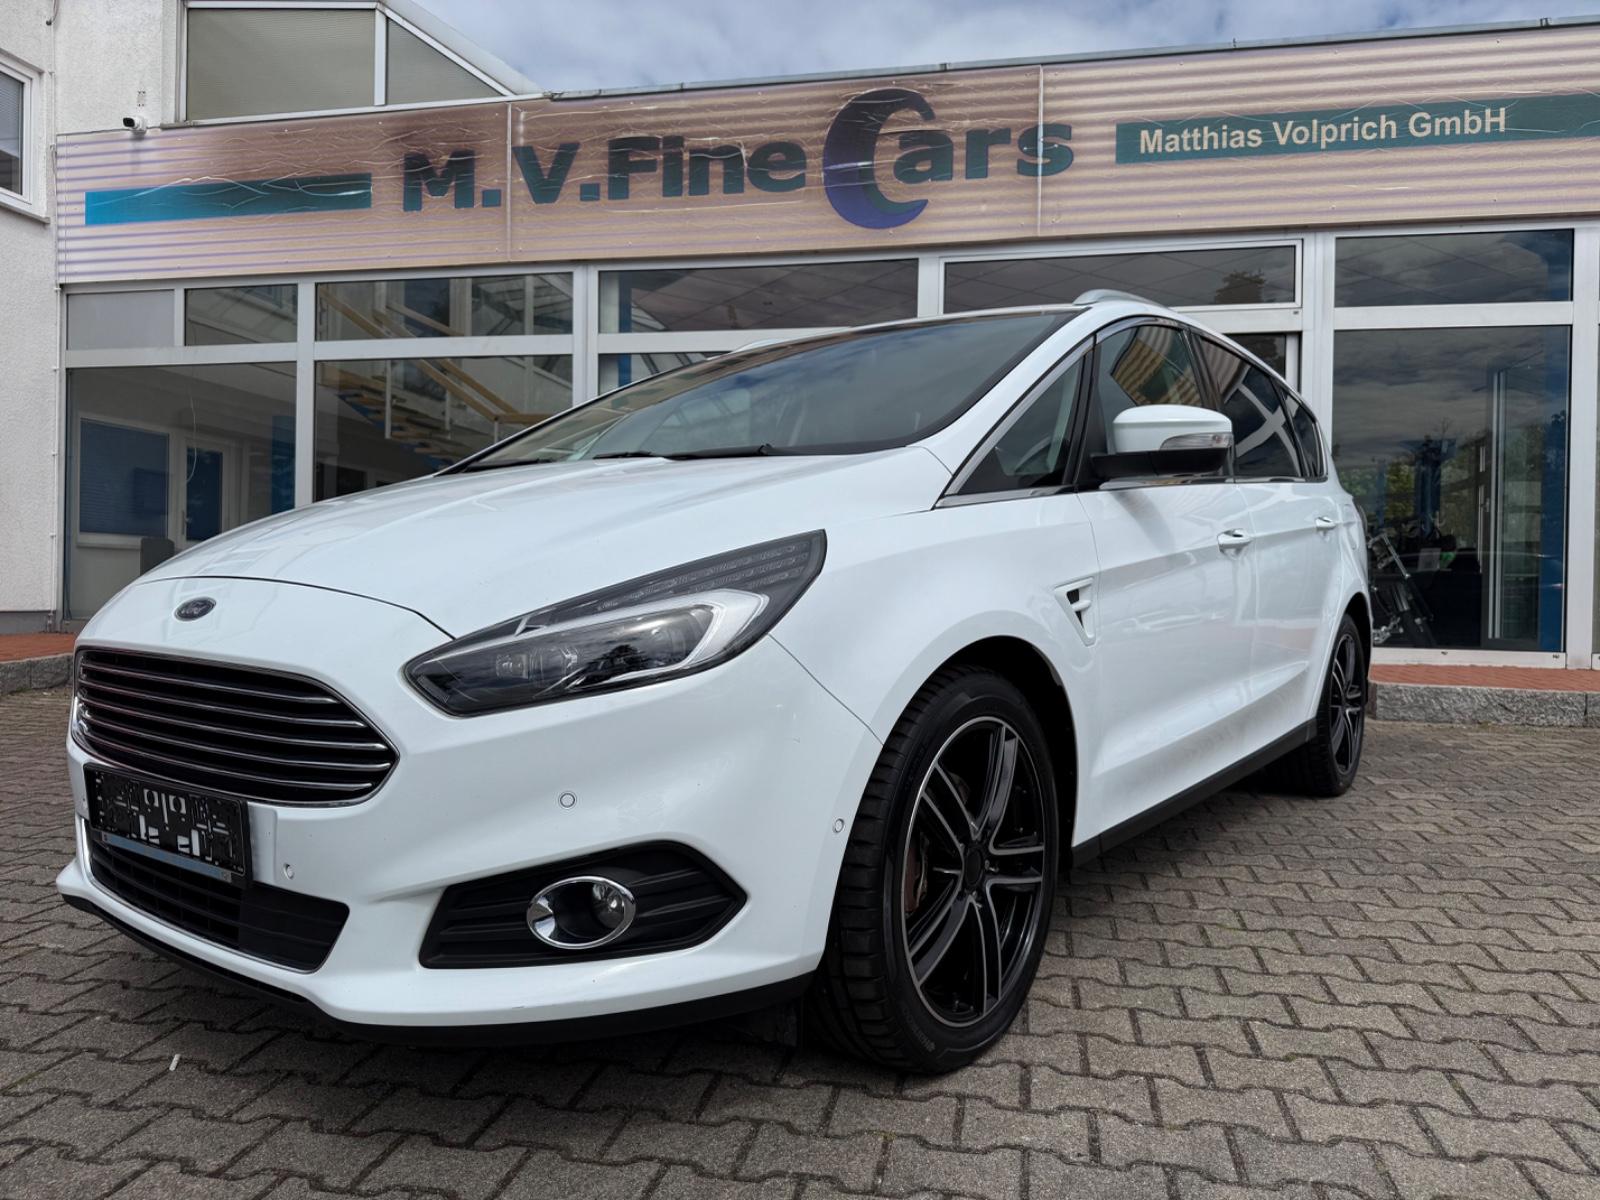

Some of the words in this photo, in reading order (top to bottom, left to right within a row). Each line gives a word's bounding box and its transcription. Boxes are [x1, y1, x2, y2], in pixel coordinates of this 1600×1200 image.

[822, 87, 1075, 231] Cars
[1139, 125, 1263, 155] Matthias
[1272, 114, 1398, 150] Volprich
[1408, 107, 1507, 138] GmbH
